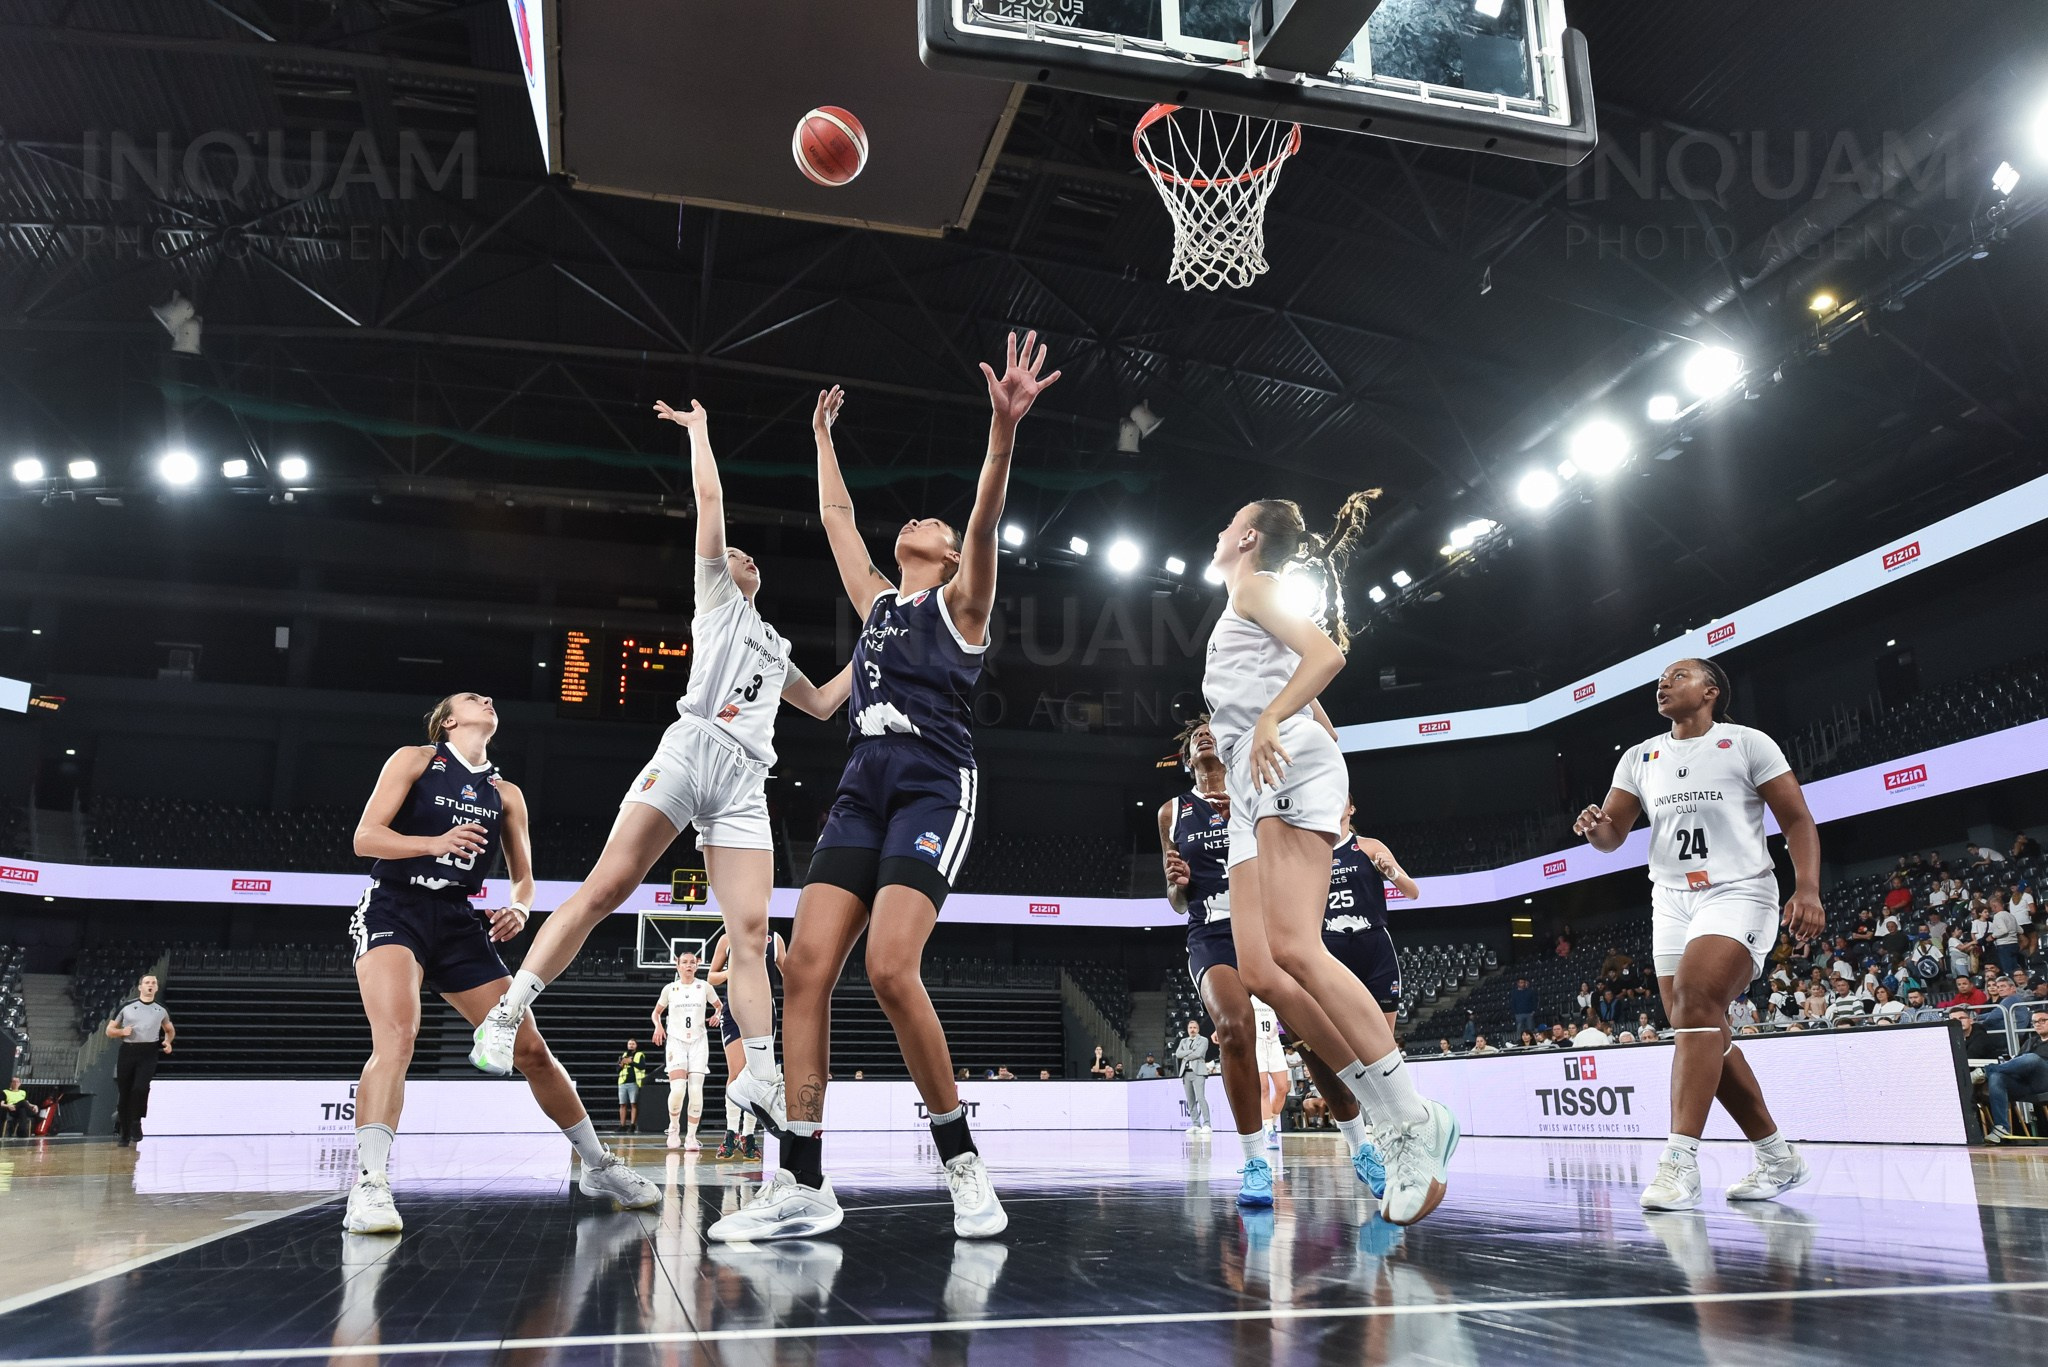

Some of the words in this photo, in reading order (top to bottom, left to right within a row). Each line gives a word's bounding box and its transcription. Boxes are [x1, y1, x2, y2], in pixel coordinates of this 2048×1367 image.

[1885, 545, 1918, 567] zizin
[1709, 625, 1733, 643] zizin
[1420, 722, 1449, 732] zizin
[1887, 768, 1924, 787] zizin
[1654, 791, 1724, 807] UNIVERSITATEA
[434, 796, 499, 820] STUDENT
[1676, 804, 1697, 815] CLUJ
[1187, 829, 1230, 843] STUDE
[1676, 828, 1709, 861] 24
[1, 867, 37, 881] zizin
[234, 880, 269, 891] zizin
[1328, 889, 1355, 910] 25
[1031, 905, 1058, 913] zizin
[685, 1016, 692, 1029] 8
[1261, 1020, 1271, 1032] 19
[1535, 1086, 1634, 1116] TISSOT
[321, 1102, 355, 1121] TIS
[1539, 1124, 1560, 1132] SWISS
[1563, 1123, 1595, 1132] WATCHES
[1598, 1124, 1619, 1132] SINCE
[1624, 1124, 1640, 1133] 1853
